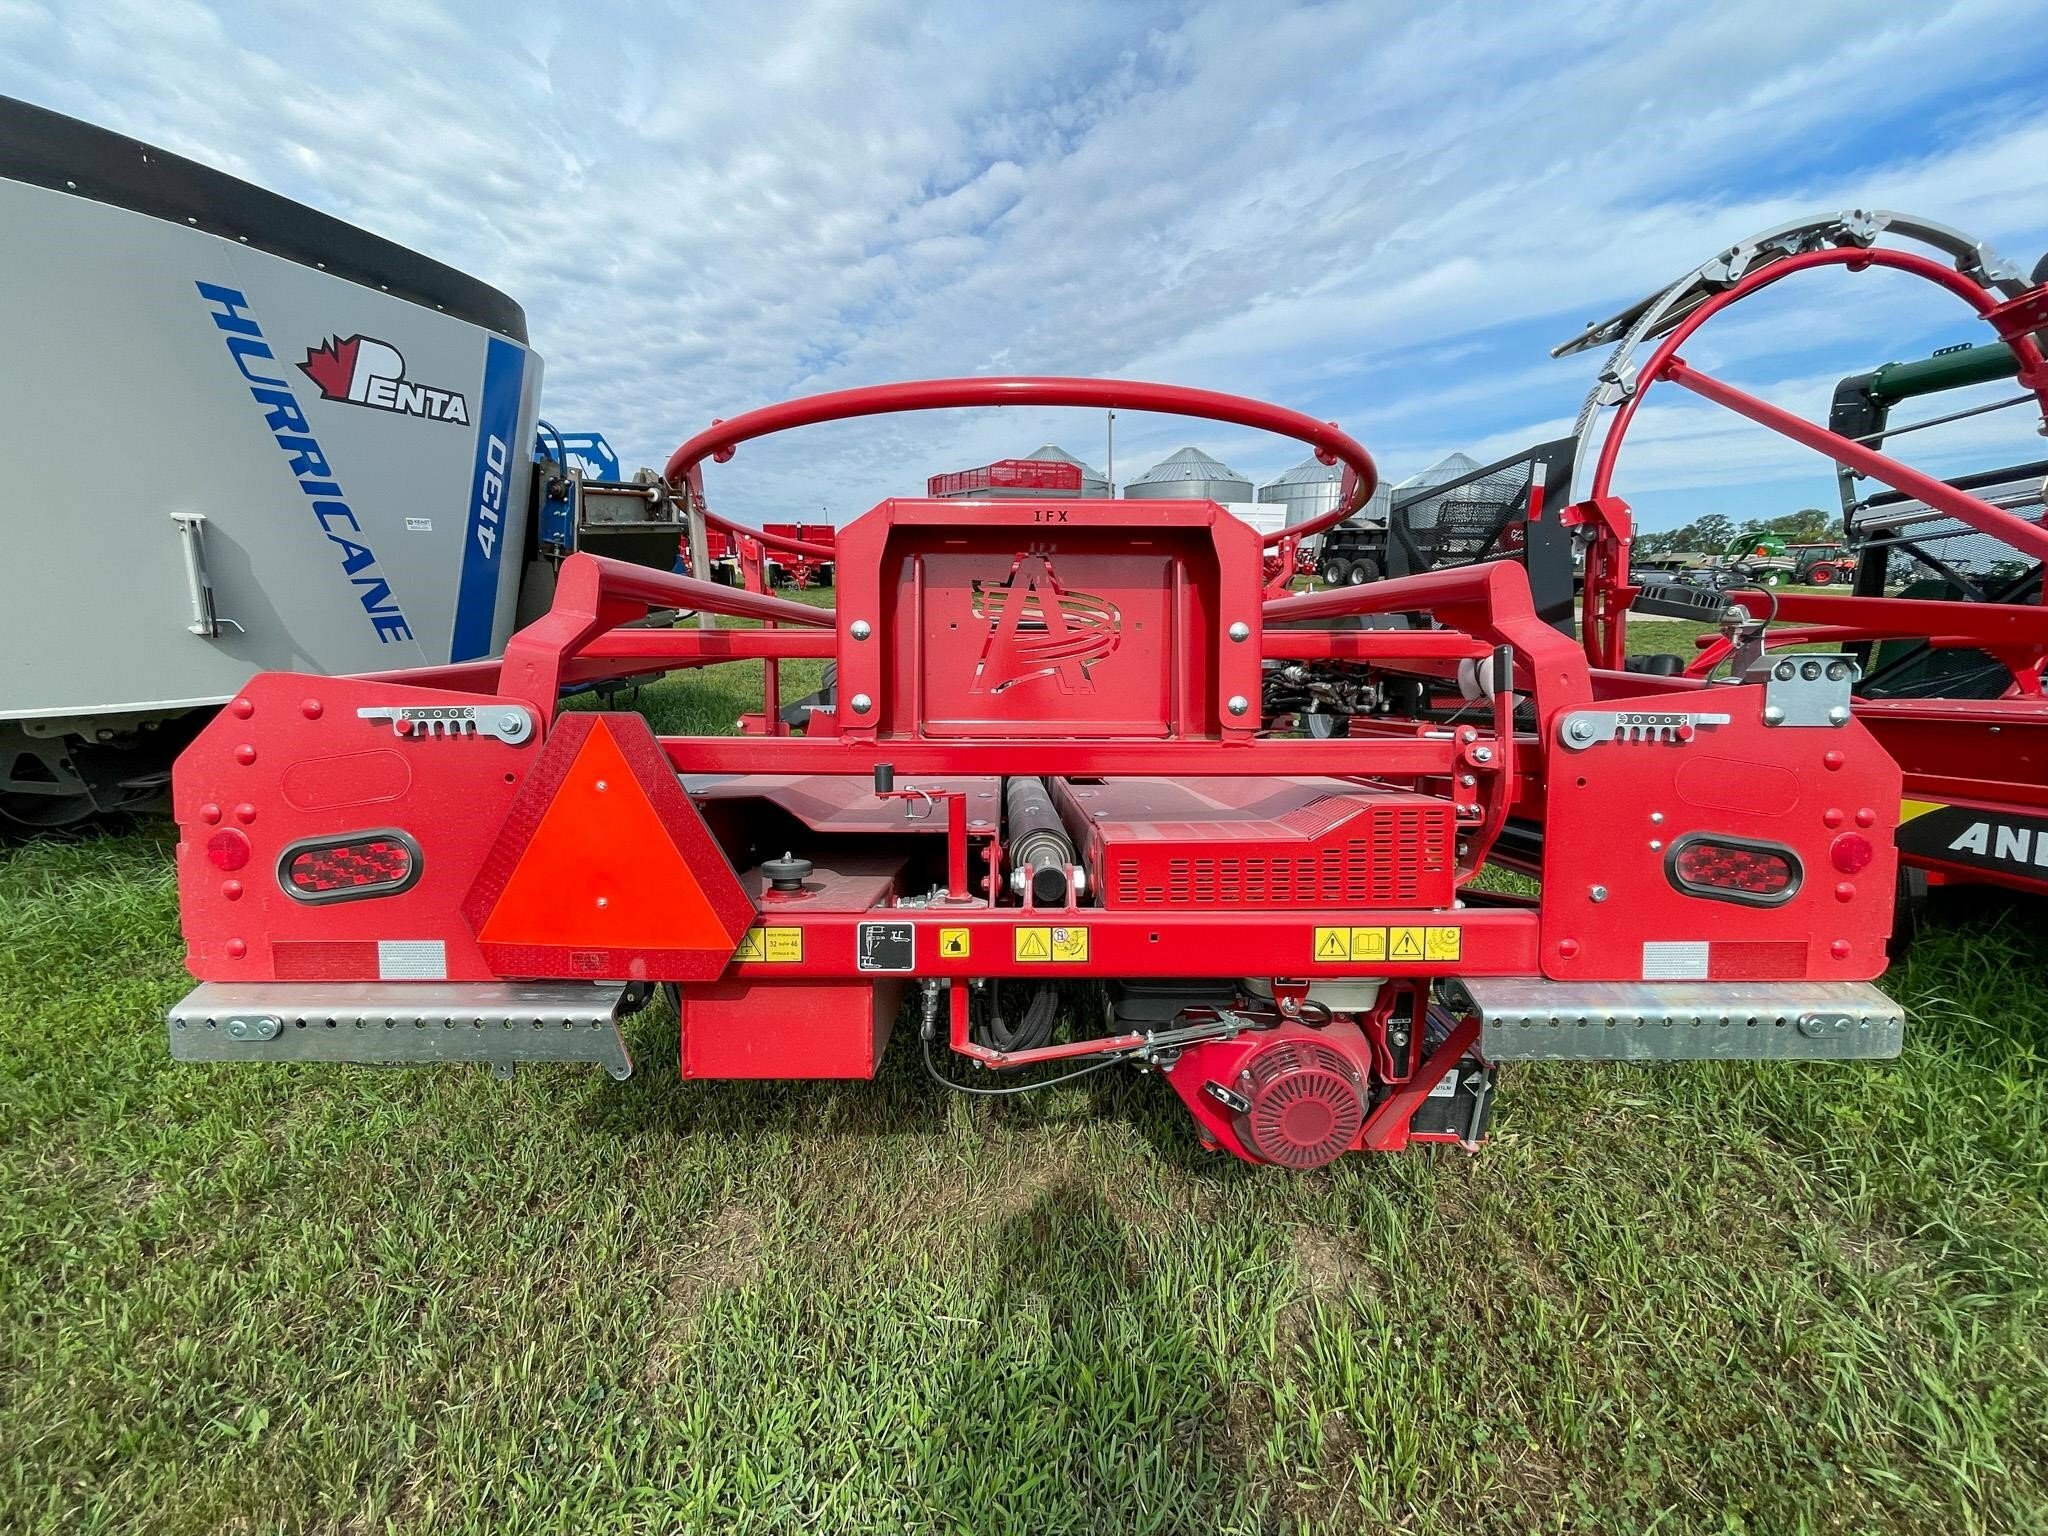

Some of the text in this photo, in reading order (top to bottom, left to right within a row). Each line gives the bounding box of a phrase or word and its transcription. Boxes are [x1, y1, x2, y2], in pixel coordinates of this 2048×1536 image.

[347, 337, 470, 425] PENTA
[195, 280, 414, 644] HURRICANE
[477, 434, 507, 560] 4130
[1034, 511, 1068, 522] IFX
